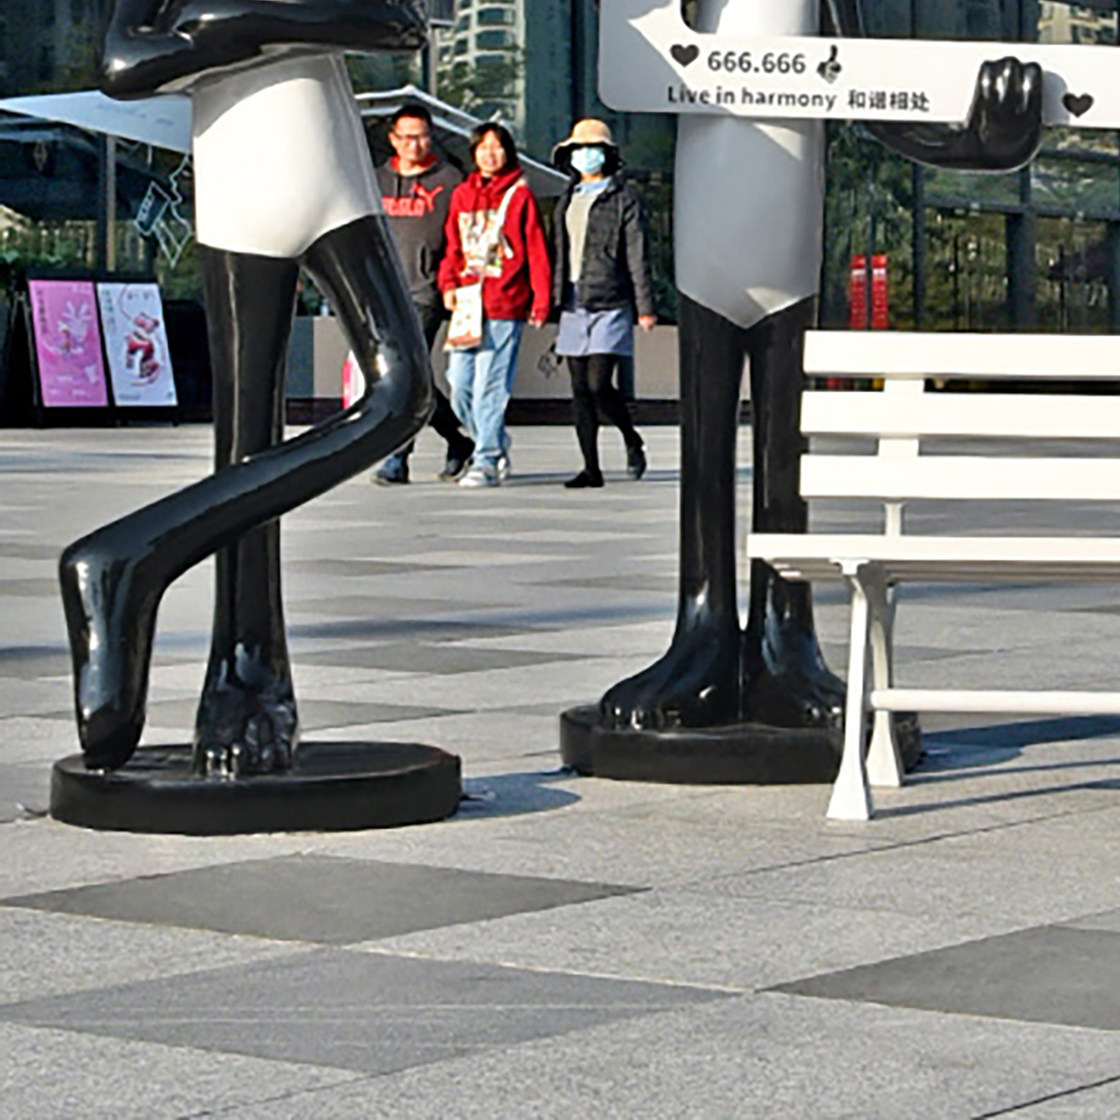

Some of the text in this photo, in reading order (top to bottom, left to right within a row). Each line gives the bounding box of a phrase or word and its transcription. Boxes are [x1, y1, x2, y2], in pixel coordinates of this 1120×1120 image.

[707, 50, 807, 75] 666.666
[667, 85, 931, 113] Live in harmony 和谐相处
